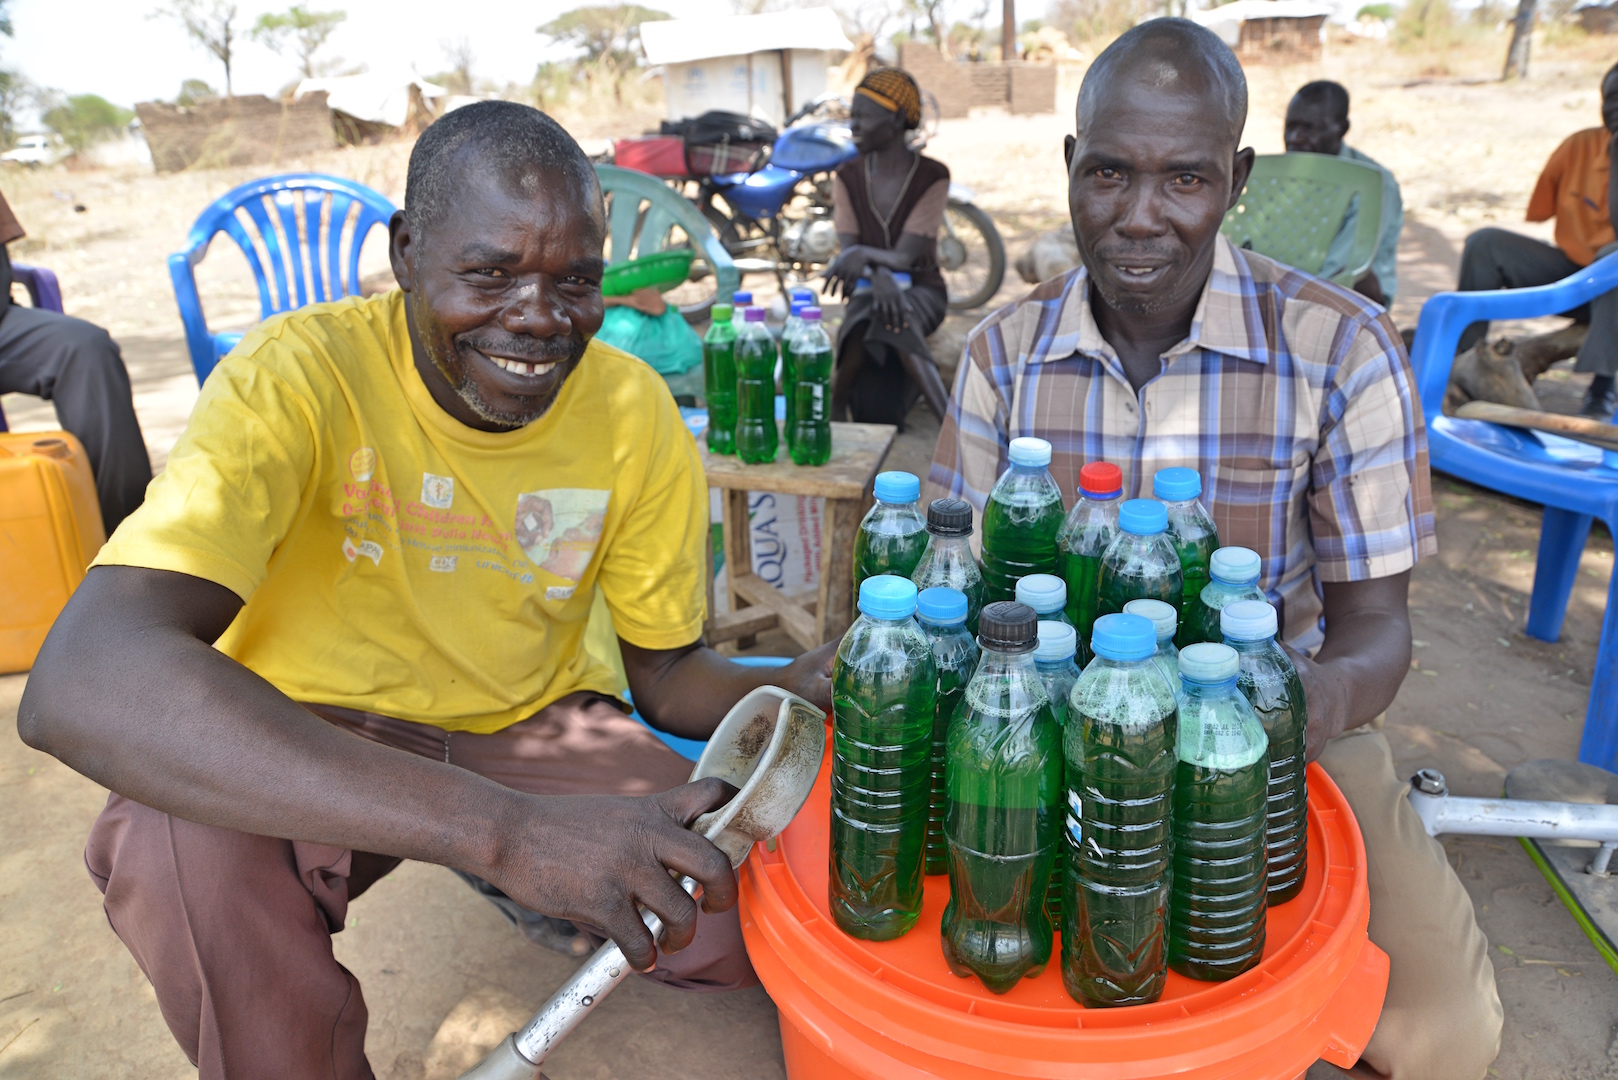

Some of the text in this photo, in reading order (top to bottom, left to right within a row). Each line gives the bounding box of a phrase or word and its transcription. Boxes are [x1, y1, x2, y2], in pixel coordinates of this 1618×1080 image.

[405, 502, 475, 525] Children
[432, 526, 467, 540] Polio
[360, 541, 381, 560] APAN
[476, 559, 519, 581] unicef
